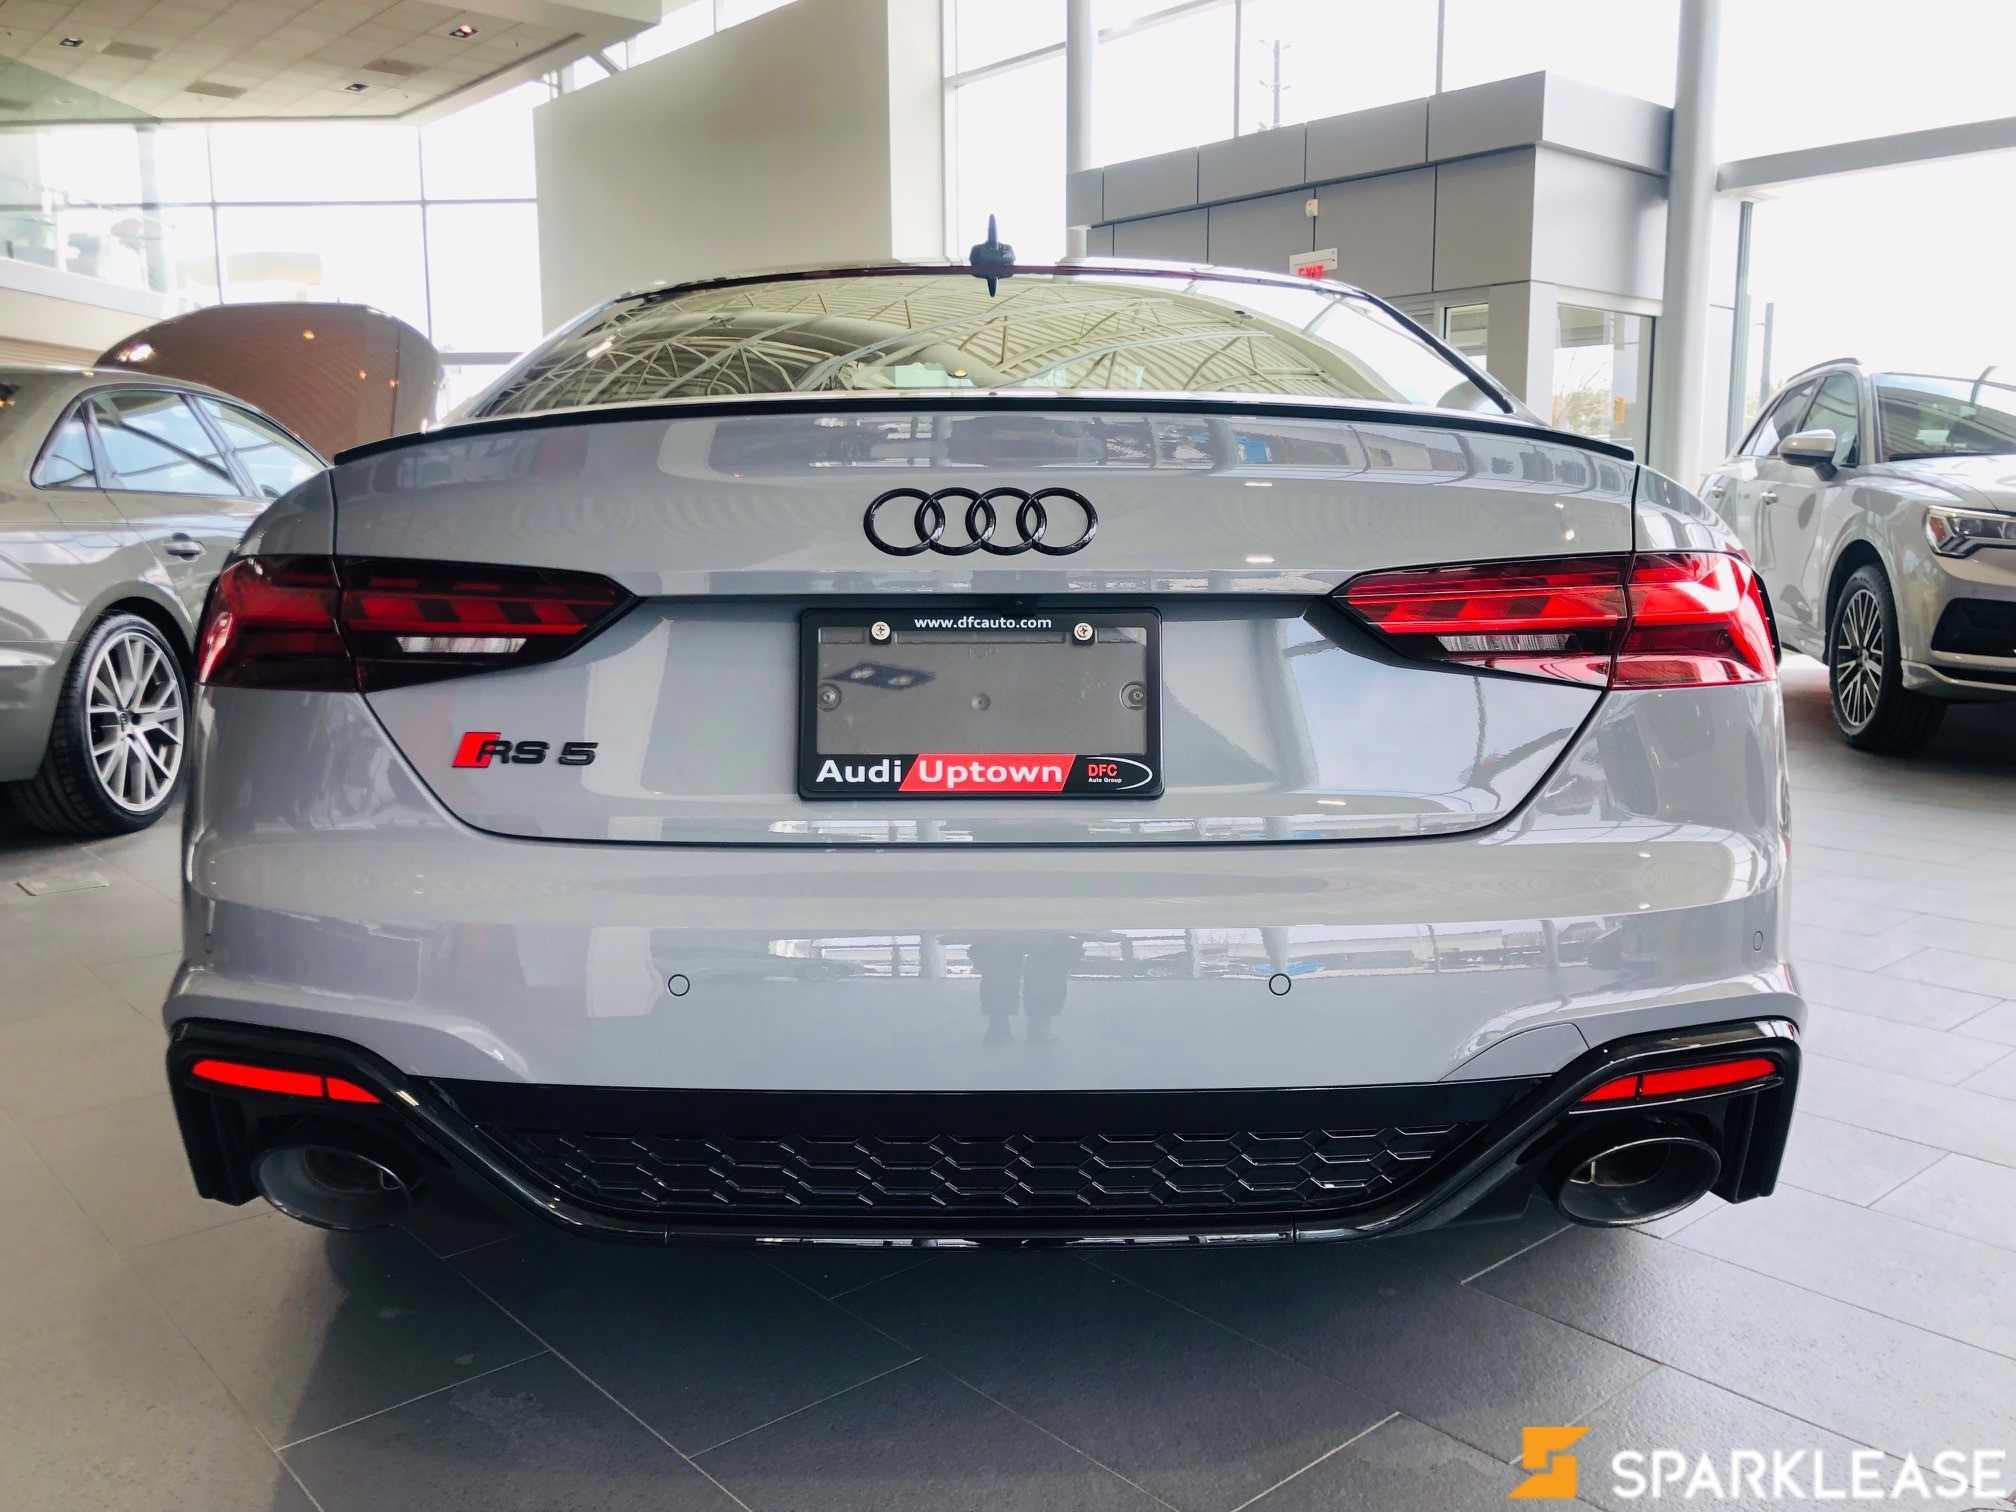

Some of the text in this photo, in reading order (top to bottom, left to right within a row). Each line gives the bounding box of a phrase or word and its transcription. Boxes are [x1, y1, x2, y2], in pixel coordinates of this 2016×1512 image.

[914, 616, 1052, 629] www.dfcauto.com
[476, 740, 599, 766] RS 5
[816, 759, 1063, 788] Audi Uptown
[1088, 764, 1118, 777] DFC
